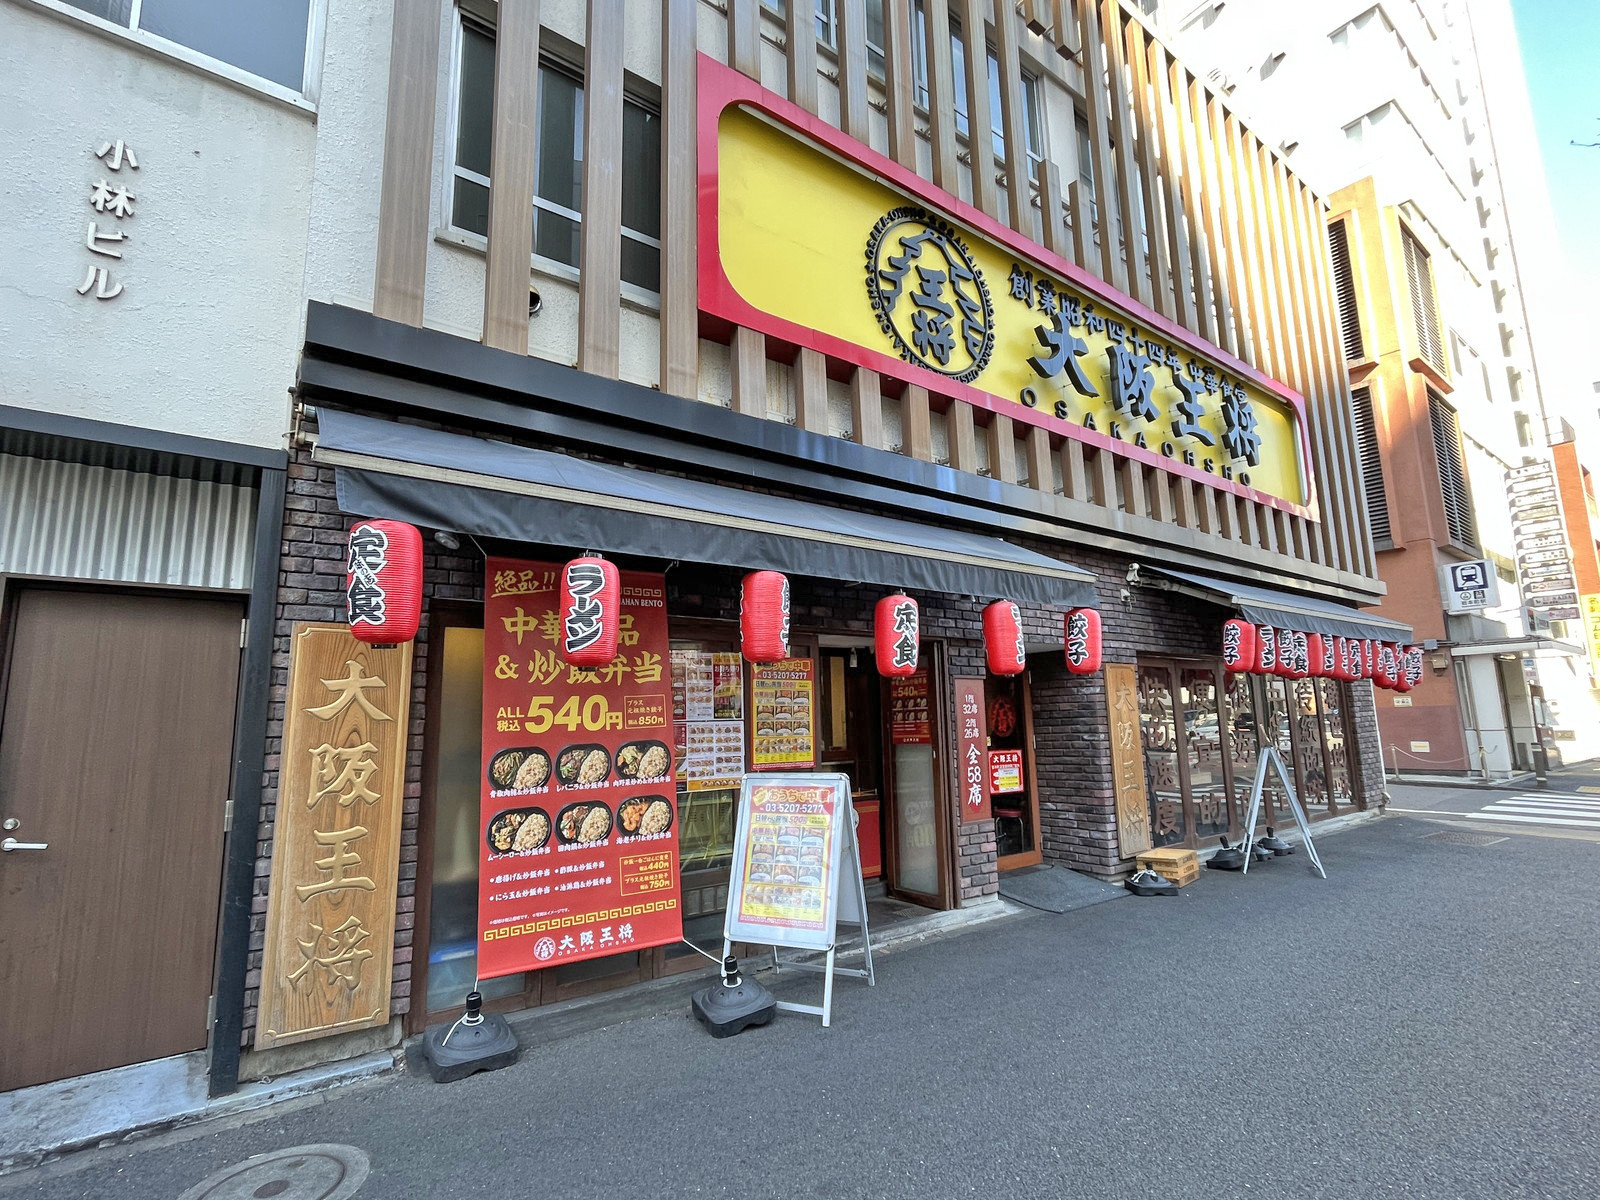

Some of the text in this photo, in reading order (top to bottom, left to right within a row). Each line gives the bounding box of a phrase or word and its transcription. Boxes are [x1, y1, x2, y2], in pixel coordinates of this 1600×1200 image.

[76, 139, 140, 299] 小林ビル
[1008, 263, 1183, 373] 創業昭和四十四年
[1026, 313, 1262, 468] 大阪王将
[493, 569, 556, 593] 絶品!!
[565, 564, 606, 653] ラーメン
[641, 598, 663, 608] BENTO
[500, 606, 641, 646] 中華品
[892, 601, 919, 667] 定食
[1066, 612, 1089, 665] 餃子
[1223, 623, 1241, 666] 餃子
[1259, 625, 1276, 668] ラーメン
[1277, 629, 1294, 668] 餃子
[1292, 634, 1310, 674] 定食
[496, 706, 525, 719] ALL
[496, 719, 521, 732] 税込
[524, 694, 623, 734] 540円
[962, 703, 978, 715] 32席
[963, 727, 980, 739] 26席
[965, 742, 982, 806] 全58席
[1113, 679, 1145, 837] 大阪王将
[765, 803, 824, 813] 03-5207-5277
[286, 659, 396, 998] 大阪王将
[557, 922, 634, 951] 大阪王将
